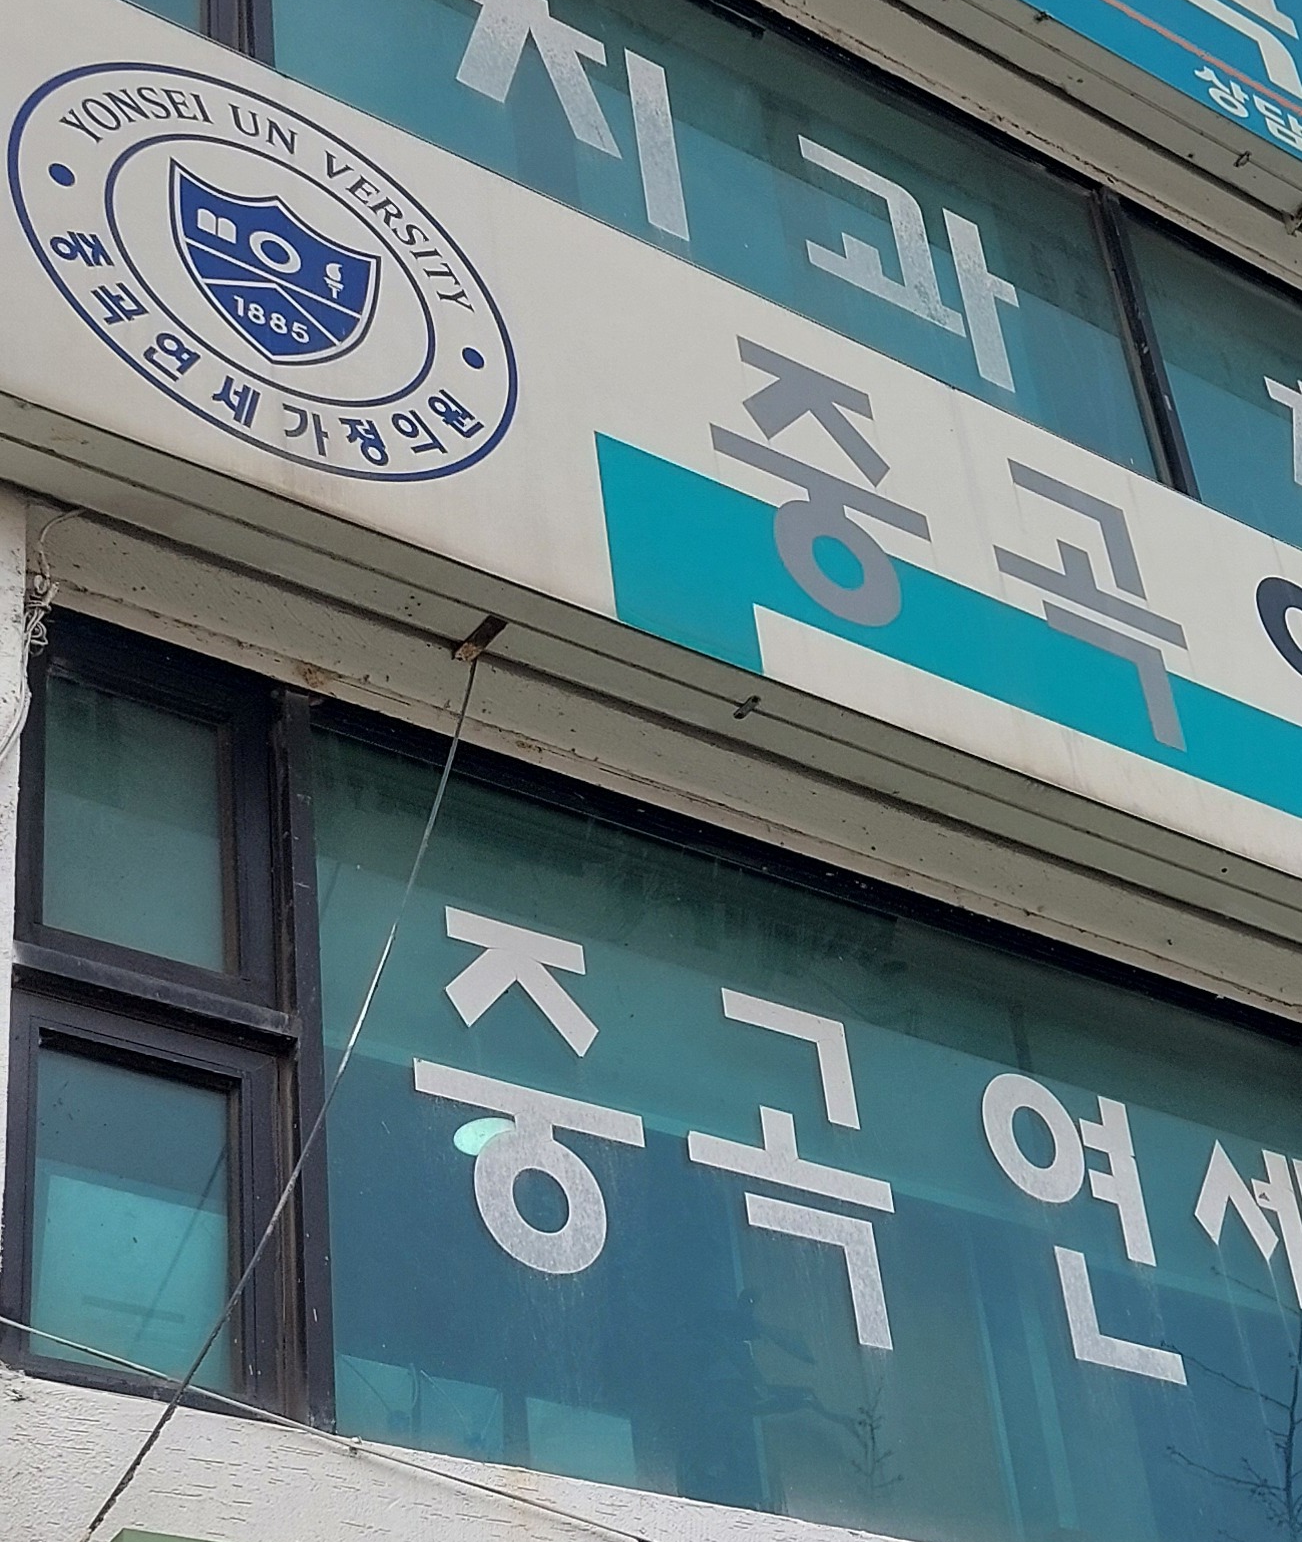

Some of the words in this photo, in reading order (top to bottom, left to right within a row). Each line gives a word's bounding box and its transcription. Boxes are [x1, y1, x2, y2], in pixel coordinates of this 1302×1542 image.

[59, 88, 214, 143] YONSEI
[233, 295, 310, 345] 1885
[50, 229, 485, 467] 중곡연세가정의원
